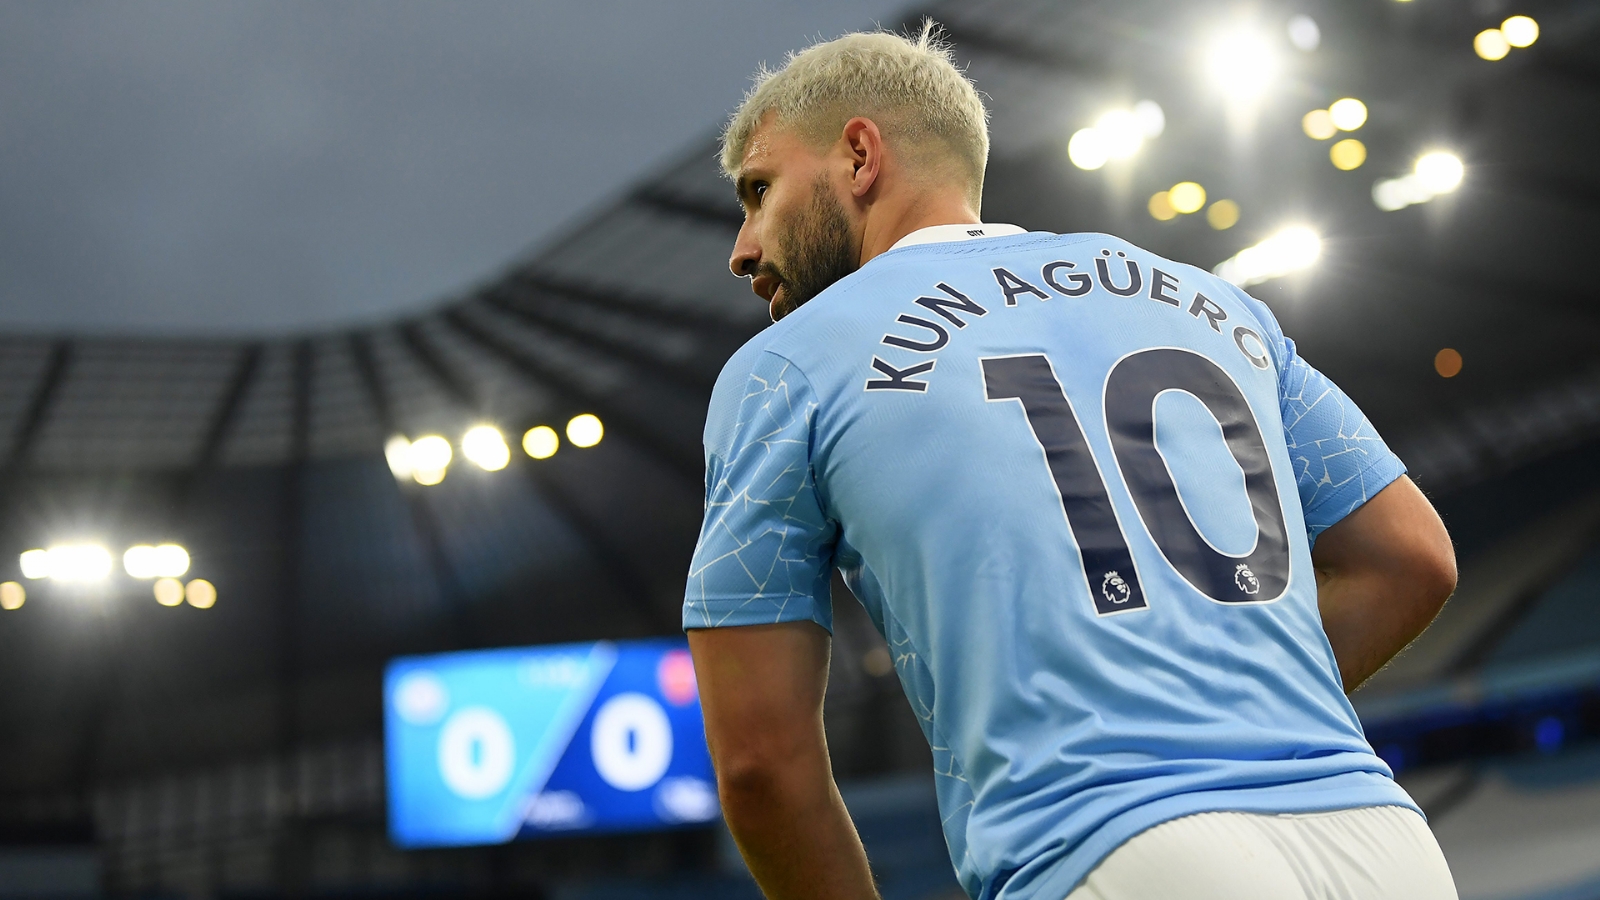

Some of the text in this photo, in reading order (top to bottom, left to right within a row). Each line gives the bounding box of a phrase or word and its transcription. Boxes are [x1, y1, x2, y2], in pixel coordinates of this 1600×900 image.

[966, 229, 985, 237] CITY
[865, 249, 1269, 392] KUN AGÜERO
[980, 347, 1290, 614] 10
[436, 692, 673, 800] 0 0
